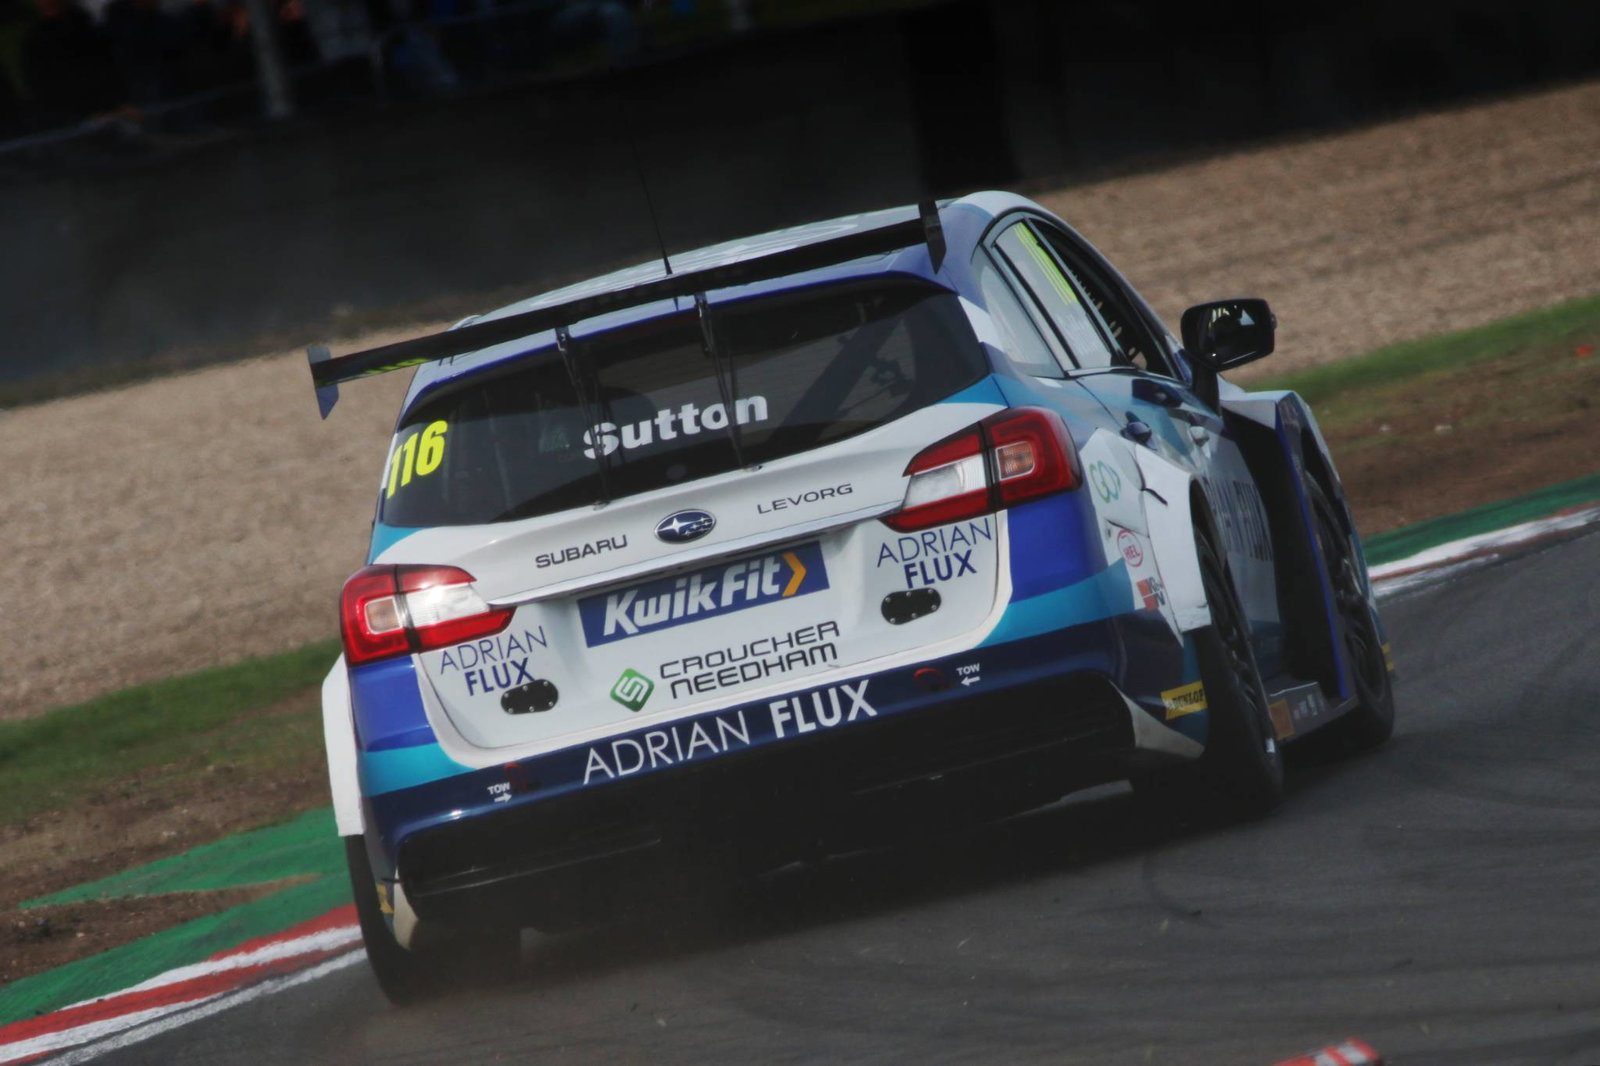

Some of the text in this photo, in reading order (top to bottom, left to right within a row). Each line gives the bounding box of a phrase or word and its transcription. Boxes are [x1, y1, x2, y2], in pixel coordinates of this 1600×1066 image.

[583, 394, 768, 460] Sutton
[385, 419, 448, 499] 116
[757, 483, 853, 514] LEVORG
[535, 534, 628, 569] SUBARU
[876, 517, 992, 568] ADRIAN
[903, 549, 977, 589] FLUX
[440, 625, 548, 675] ADRIAN
[659, 620, 840, 680] CROUCHER
[669, 642, 838, 699] NEEDHAM
[956, 663, 981, 676] TOW
[464, 657, 534, 697] FLUX
[583, 679, 878, 784] ADRIAN FLUX
[487, 782, 511, 794] TOW
